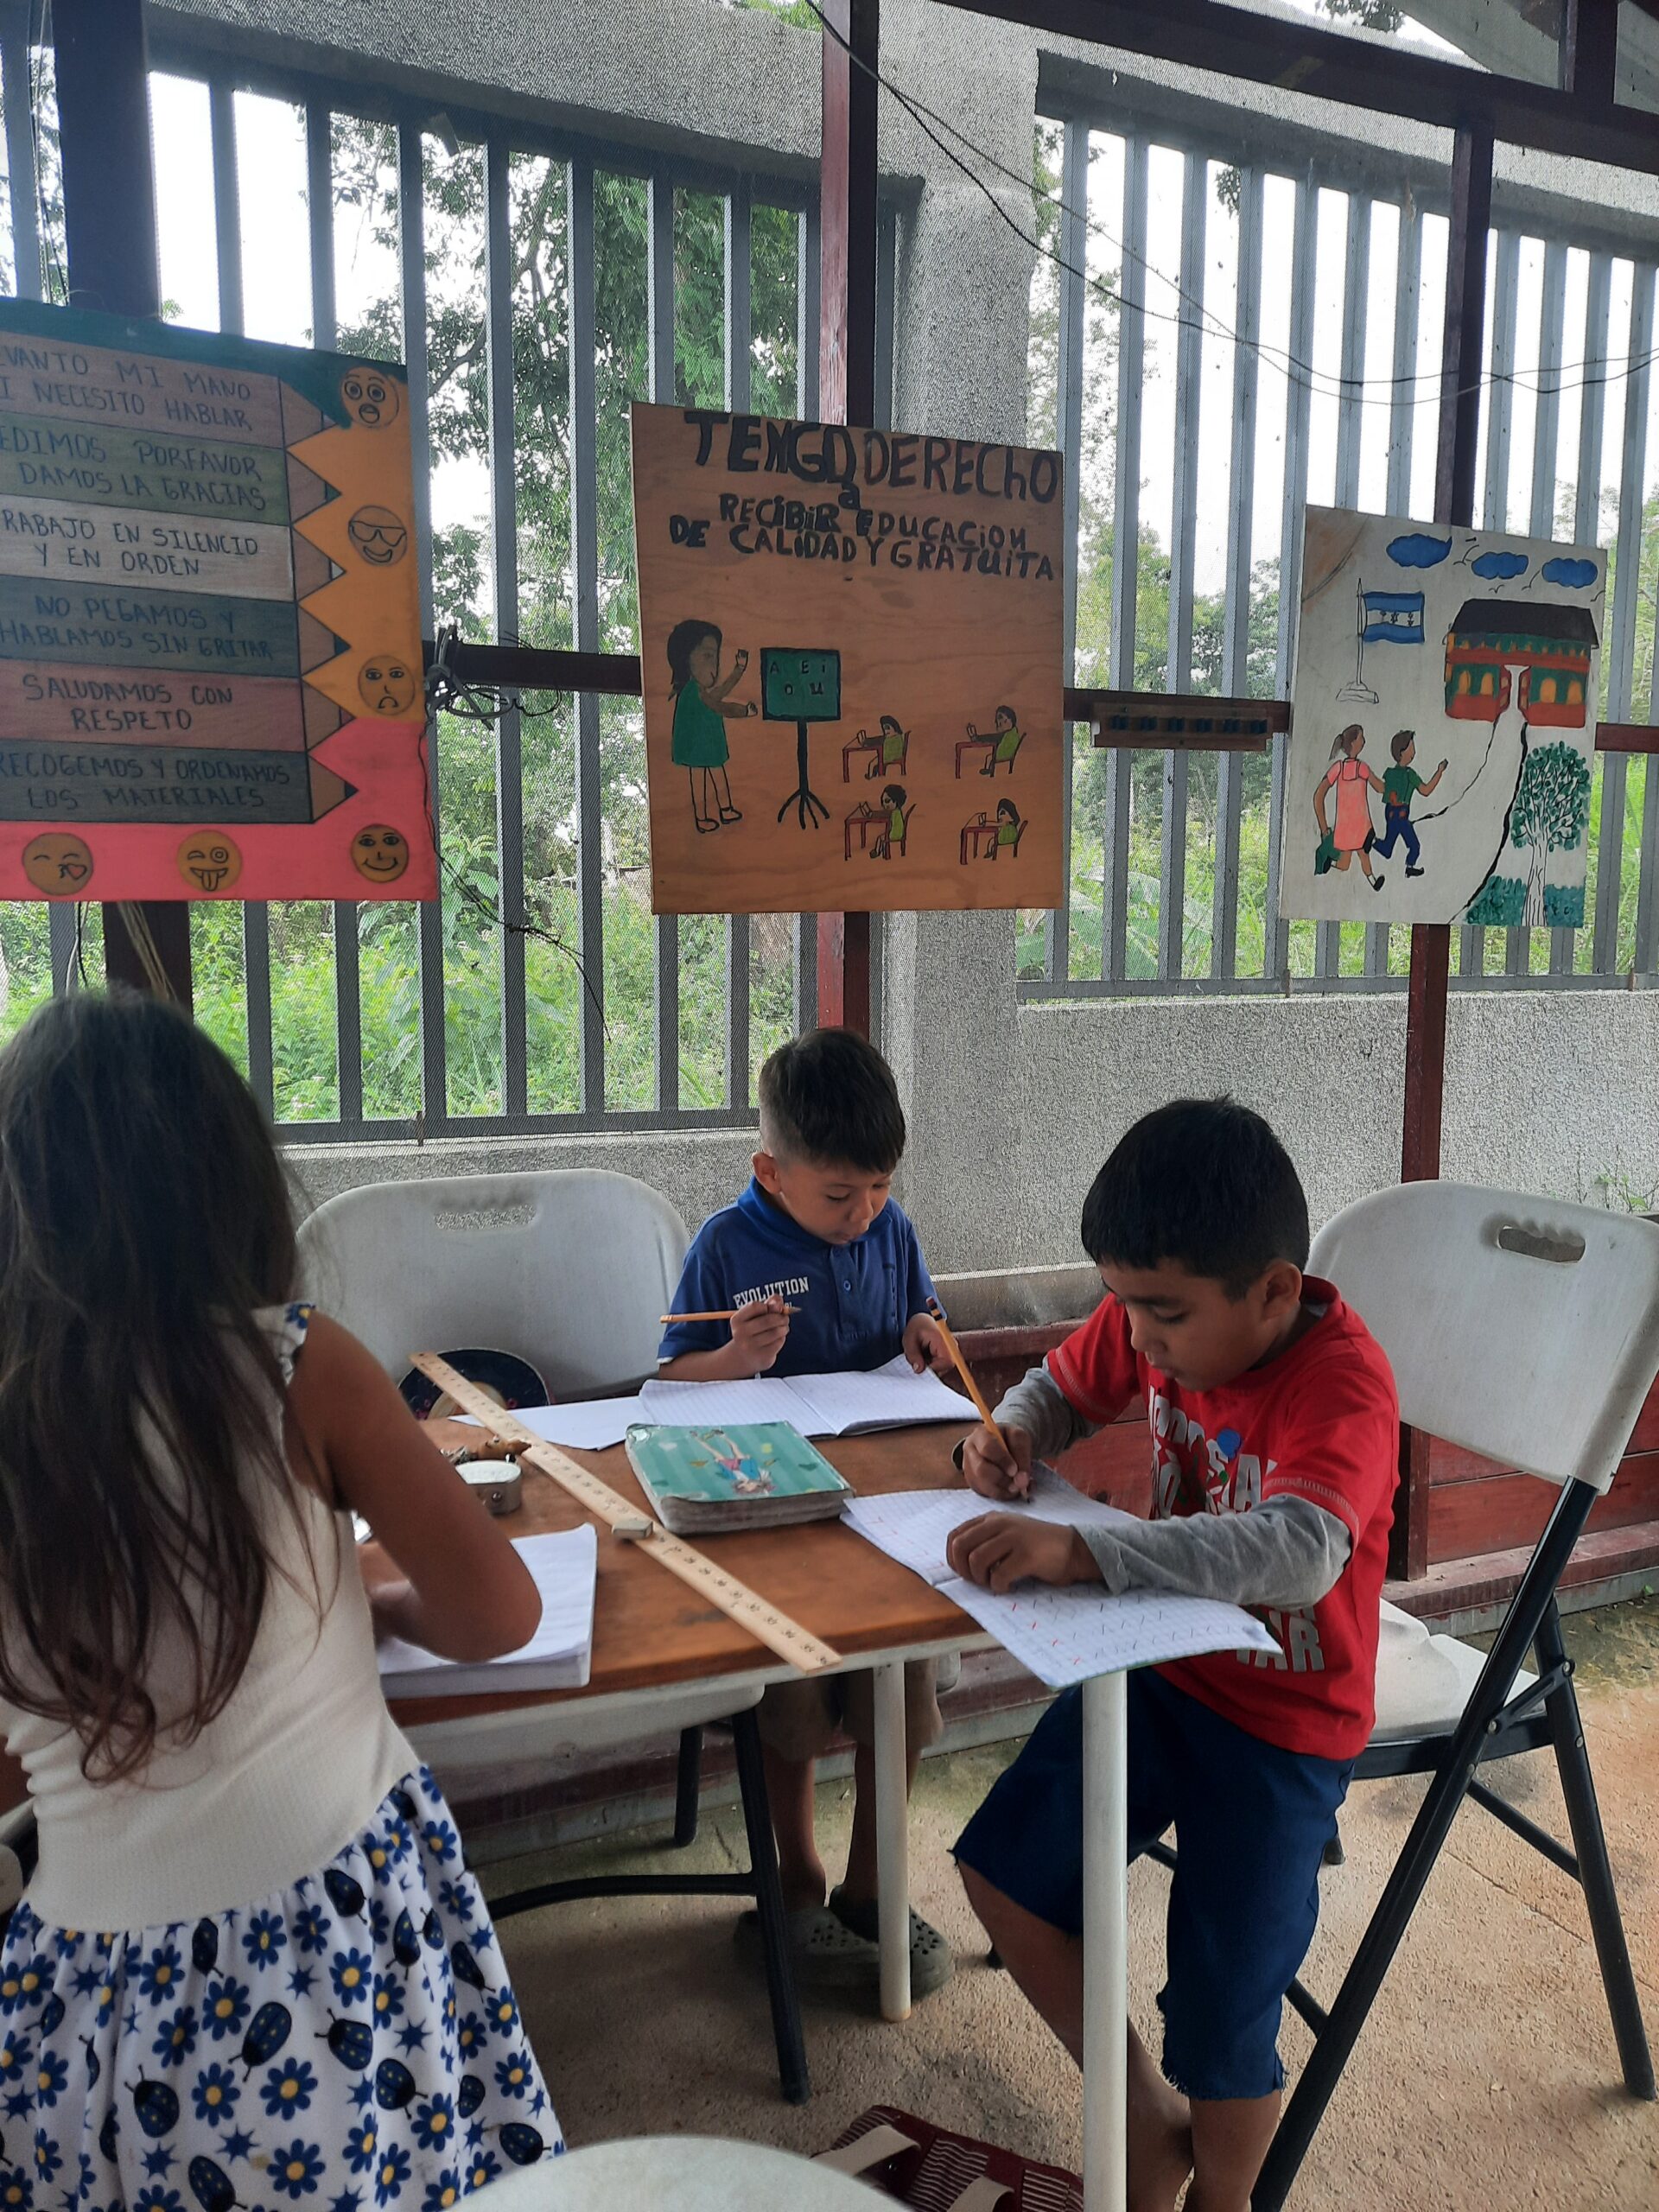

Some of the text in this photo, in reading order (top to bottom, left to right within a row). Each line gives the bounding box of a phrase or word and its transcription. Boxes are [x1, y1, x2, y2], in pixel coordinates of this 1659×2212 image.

[0, 346, 251, 402] VANTO MI MANO
[0, 376, 252, 431] I NECESITO HABLAR
[0, 425, 262, 482] EDIMOS PORFAVOR
[683, 410, 856, 483] TENGO
[19, 461, 267, 512] DAMOS LA GRACIAS
[2, 509, 258, 556] RABAJO EN SILENCIO
[669, 514, 711, 548] DE
[867, 537, 886, 567] Y
[35, 543, 200, 575] Y EN ORDEN
[35, 594, 235, 633] NO PEGAMOS Y
[0, 620, 274, 660] HABLAMOS SIN GRITAR
[801, 659, 810, 674] E
[22, 673, 233, 706] SALUDAMOS CON
[71, 708, 192, 733] RESPETO
[150, 758, 165, 778] Y
[175, 758, 290, 785] ORDENAMOS
[28, 785, 265, 810] LOS MATERIALES
[733, 1276, 810, 1309] EVOLUTION
